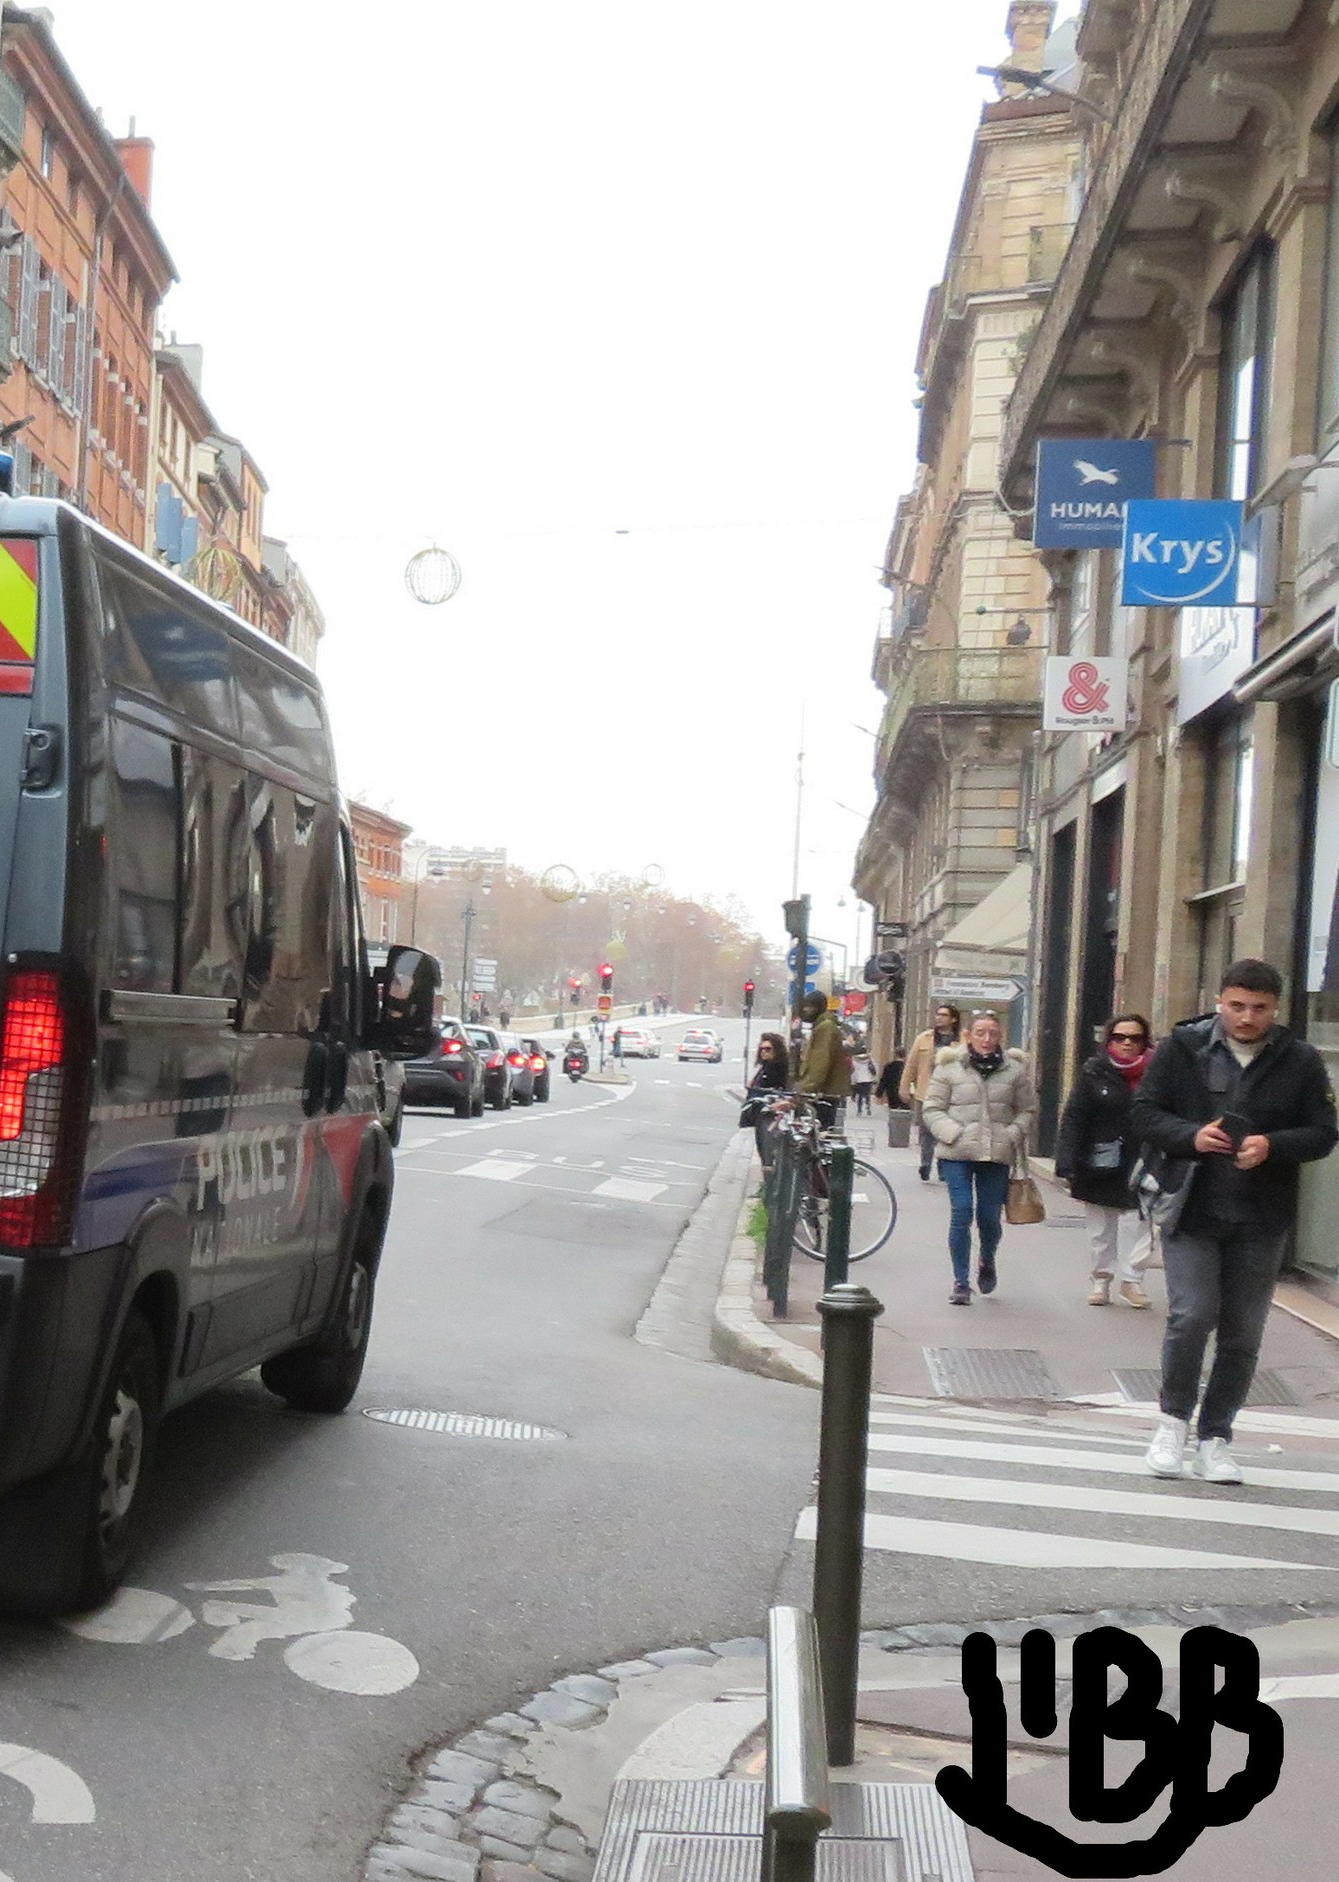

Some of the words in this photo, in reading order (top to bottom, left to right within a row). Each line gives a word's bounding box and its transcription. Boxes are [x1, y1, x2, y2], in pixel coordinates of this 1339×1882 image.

[1050, 502, 1126, 519] HUMA
[1131, 532, 1224, 575] Krys
[196, 1124, 289, 1212] POLICE
